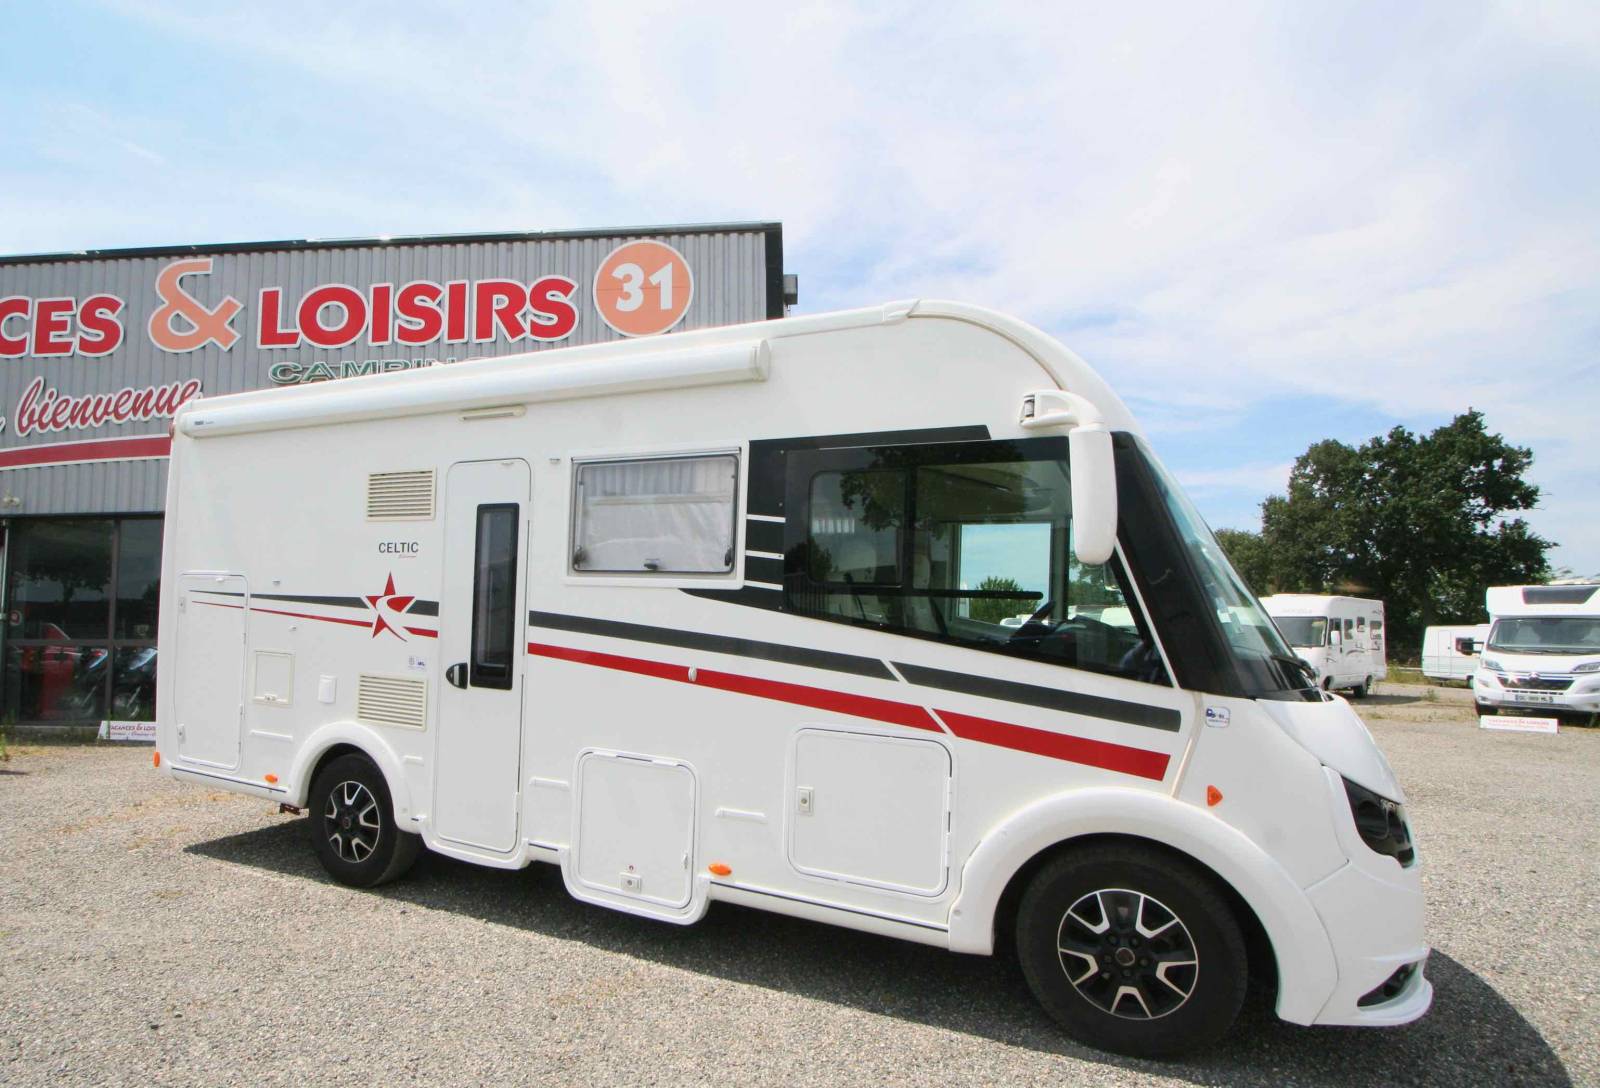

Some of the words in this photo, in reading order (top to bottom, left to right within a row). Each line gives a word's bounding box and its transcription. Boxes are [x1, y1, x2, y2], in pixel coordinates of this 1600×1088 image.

[0, 294, 125, 358] CES
[149, 258, 243, 353] &
[256, 274, 579, 350] LOISIRS
[612, 262, 673, 312] 31
[15, 376, 201, 437] bienvenue
[378, 542, 419, 553] CELTIC
